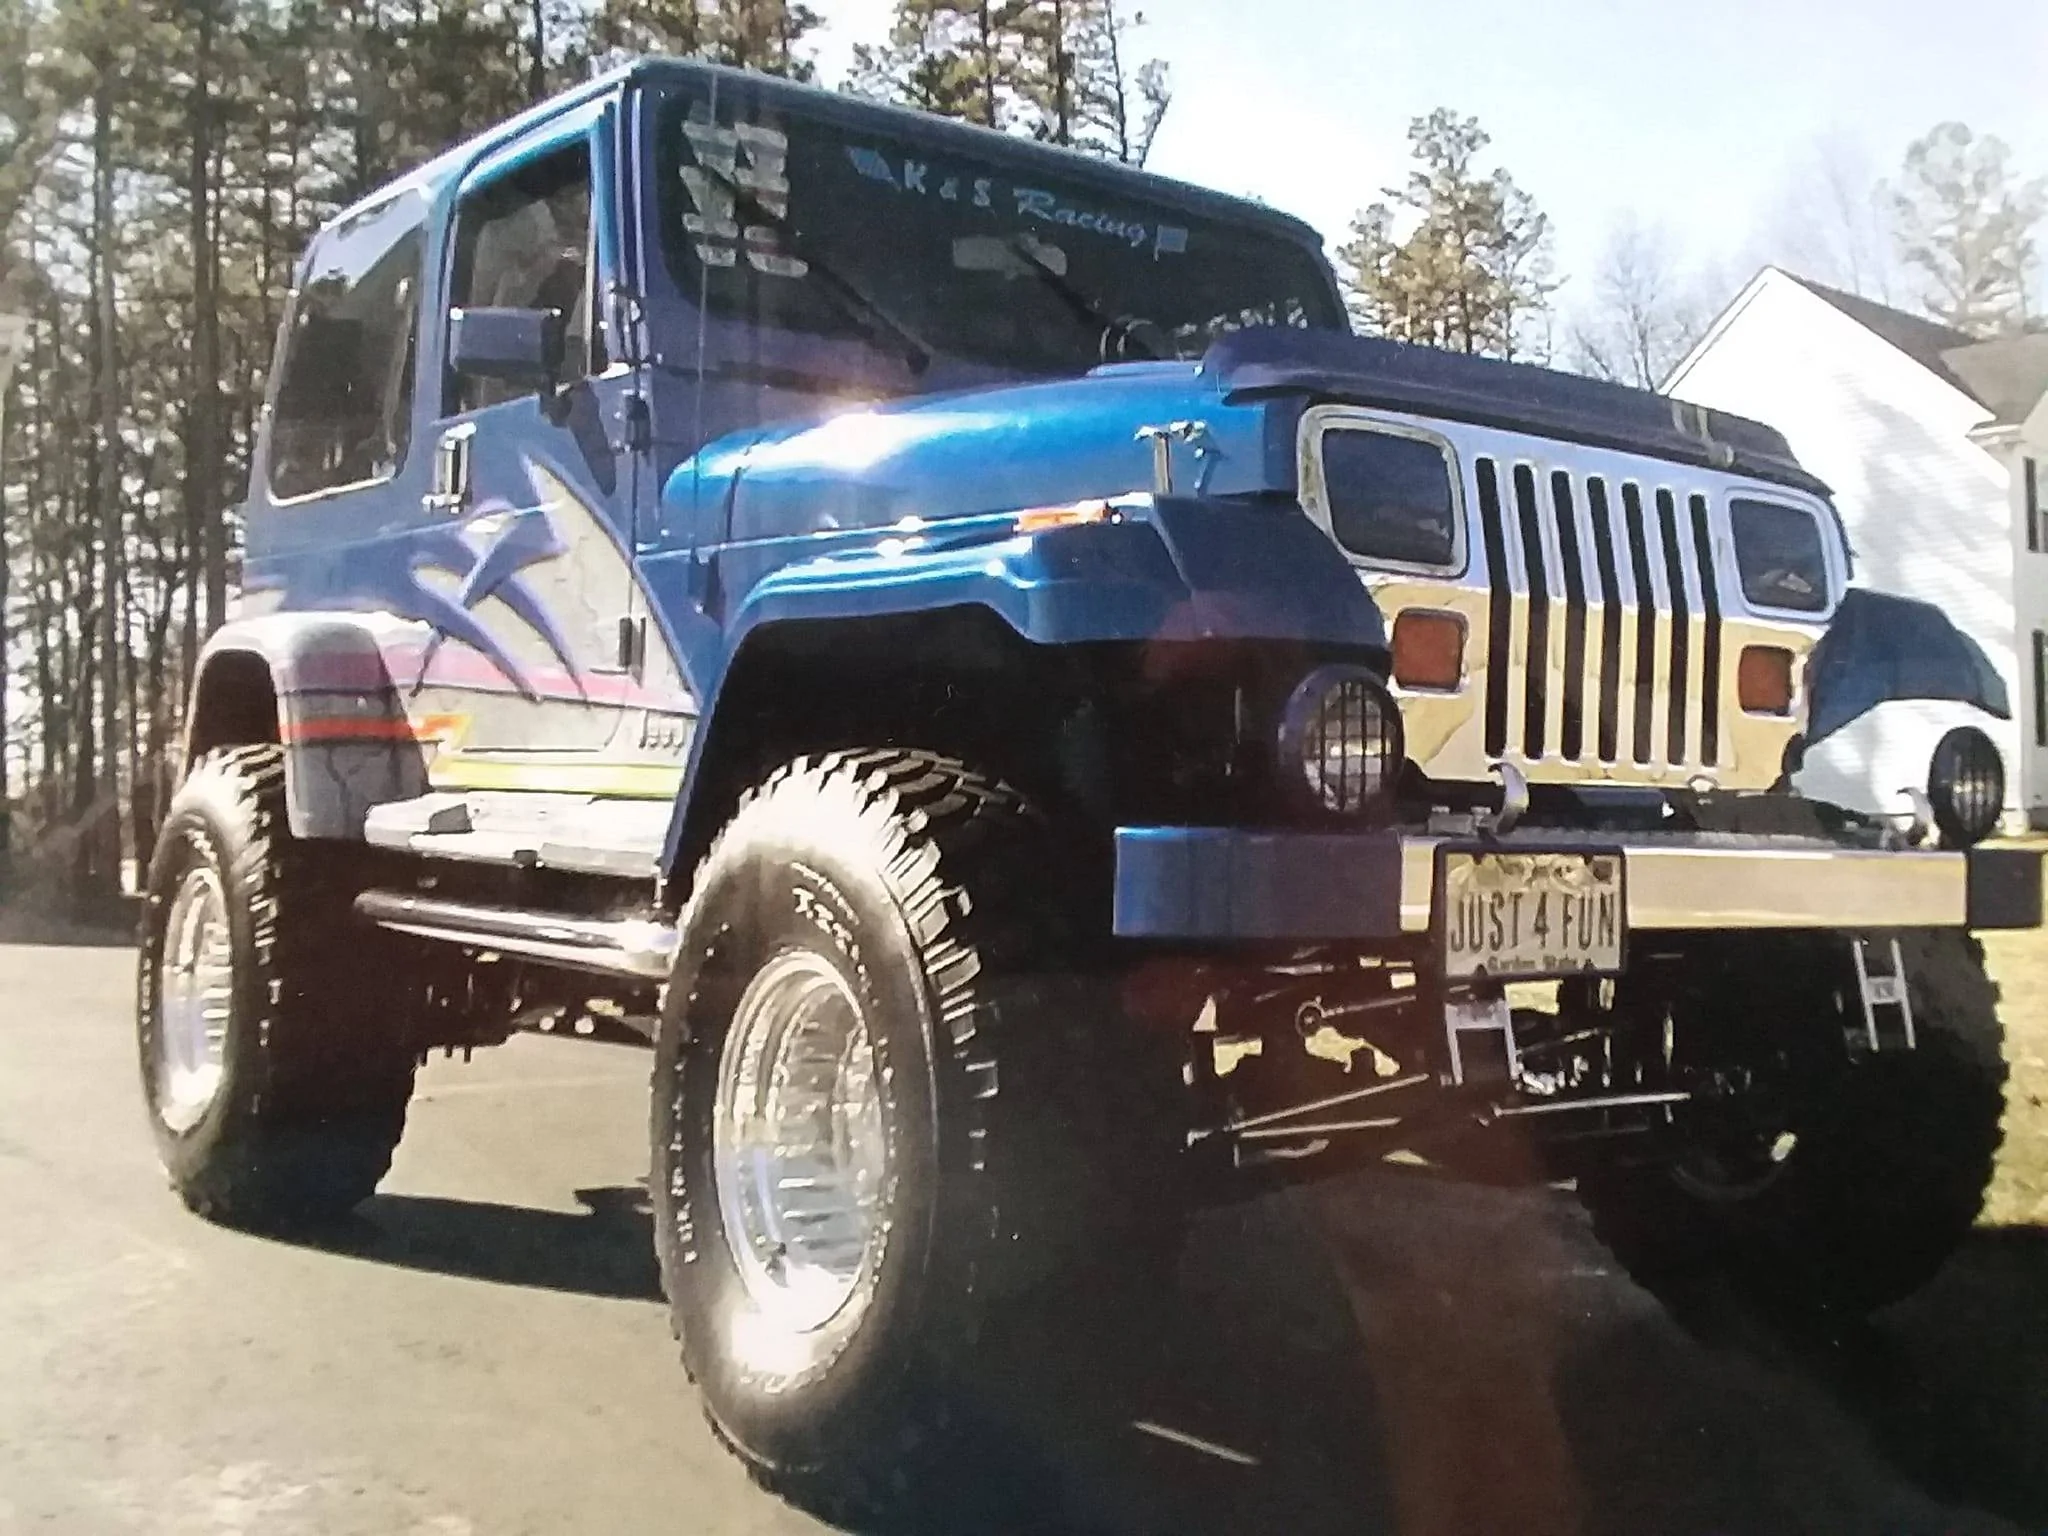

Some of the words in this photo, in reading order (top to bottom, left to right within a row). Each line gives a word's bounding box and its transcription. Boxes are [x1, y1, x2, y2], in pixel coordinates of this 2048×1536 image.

[903, 159, 927, 194] K
[973, 179, 991, 207] S
[1013, 187, 1146, 247] Racing
[1451, 892, 1523, 951] JUST
[1534, 891, 1549, 948] 4
[1563, 893, 1614, 949] FUN
